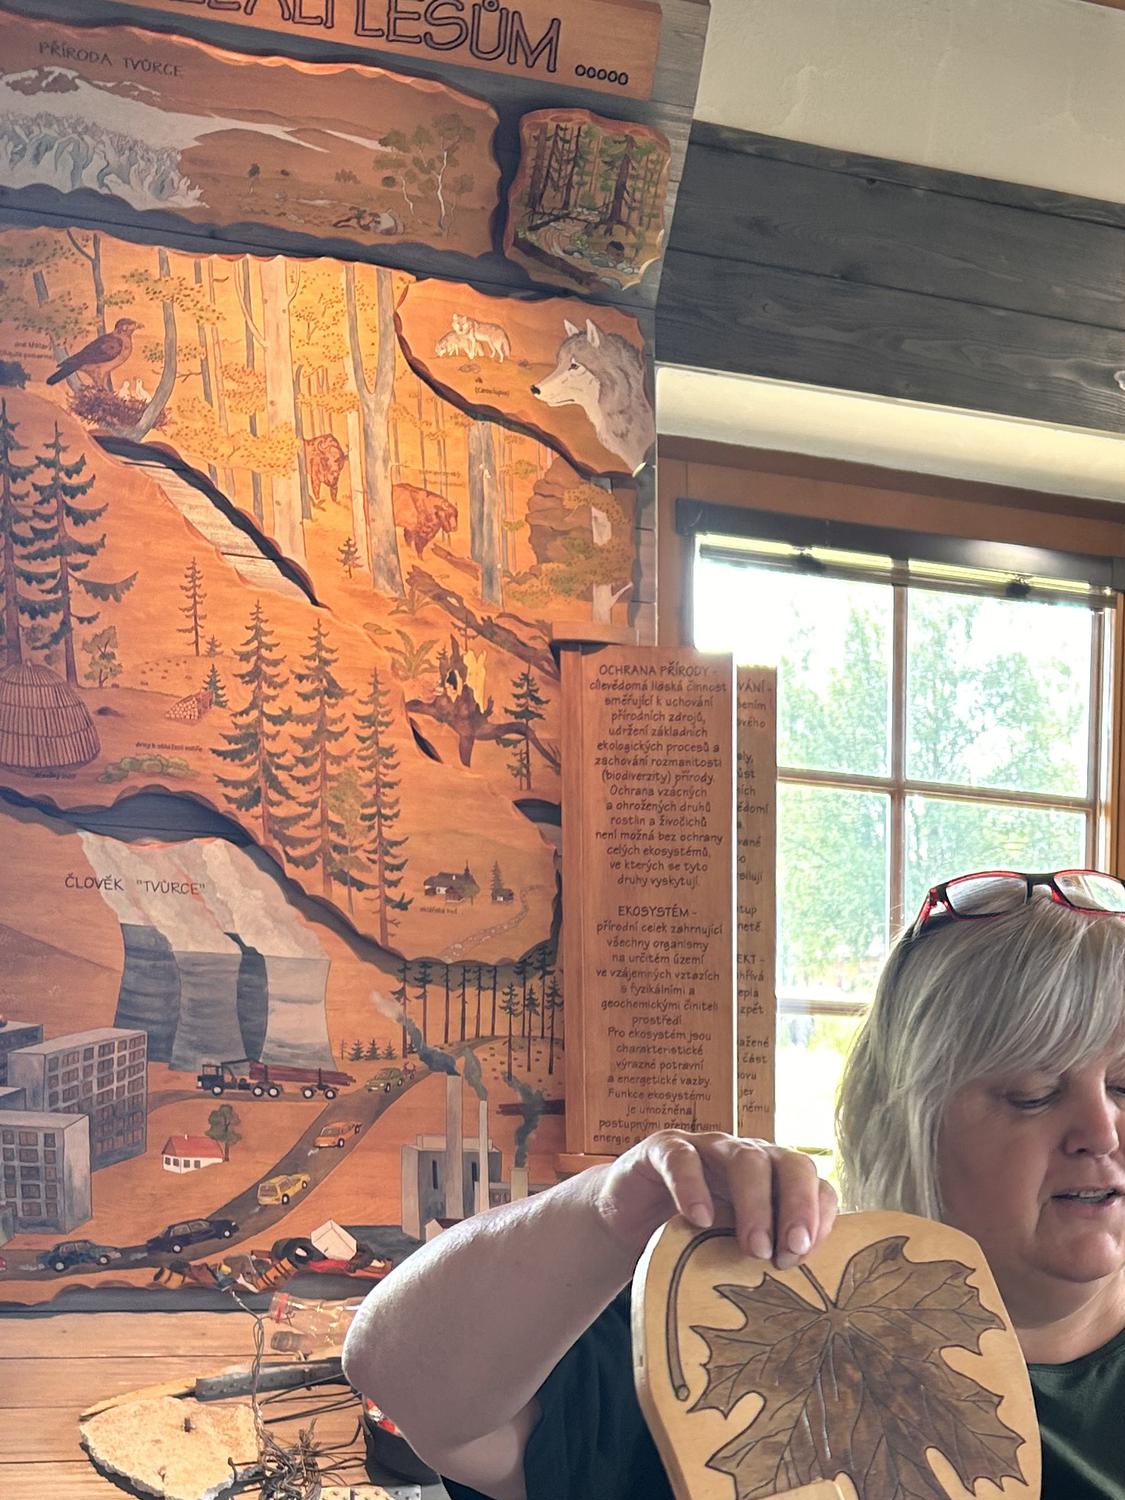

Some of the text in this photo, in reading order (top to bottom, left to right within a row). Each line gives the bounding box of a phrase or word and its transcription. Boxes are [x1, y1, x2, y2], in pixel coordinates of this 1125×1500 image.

[353, 0, 562, 73] LESŮM
[38, 40, 113, 66] PŘÍRODA
[599, 664, 656, 676] OCHRANA
[661, 661, 709, 677] PŘÍRODY
[605, 694, 713, 709] směřující k uchování
[611, 709, 665, 724] přírodních
[608, 725, 708, 739] udržení základních
[597, 740, 720, 756] ekologických procesů a
[594, 755, 722, 768] zachování rozmanitosti
[601, 768, 671, 784] (biodiverzity)
[609, 784, 707, 800] Ochrana vzácných
[606, 799, 711, 814] a ohrožených druhů
[610, 815, 708, 828] rostlin a živočichů
[595, 829, 723, 846] není možná bez ochrany
[607, 844, 640, 857] celých
[609, 859, 708, 874] ve kterých se tyto
[64, 872, 207, 896] ČLOVĚK "TVŮRCE"
[617, 874, 648, 887] druhy
[618, 903, 689, 918] EKOSYSTÉM
[597, 920, 723, 938] přírodní celek zahrnující
[606, 936, 709, 952] všechny organismy
[612, 952, 705, 965] na určitém území
[596, 966, 720, 981] ve vzájemných vztazích
[630, 982, 686, 997] fyzikálními
[689, 988, 696, 996] a
[601, 999, 718, 1012] geochemickými činiteli
[608, 1026, 712, 1044] Pro ekosystém jsou
[616, 1043, 703, 1056] charakteristické
[660, 1059, 704, 1073] potravní
[607, 1074, 615, 1084] a
[617, 1074, 677, 1087] energetické
[608, 1087, 711, 1103] Funkce ekosystému
[626, 1105, 636, 1117] je
[599, 1119, 659, 1132] postupnými
[593, 1134, 630, 1146] energie
